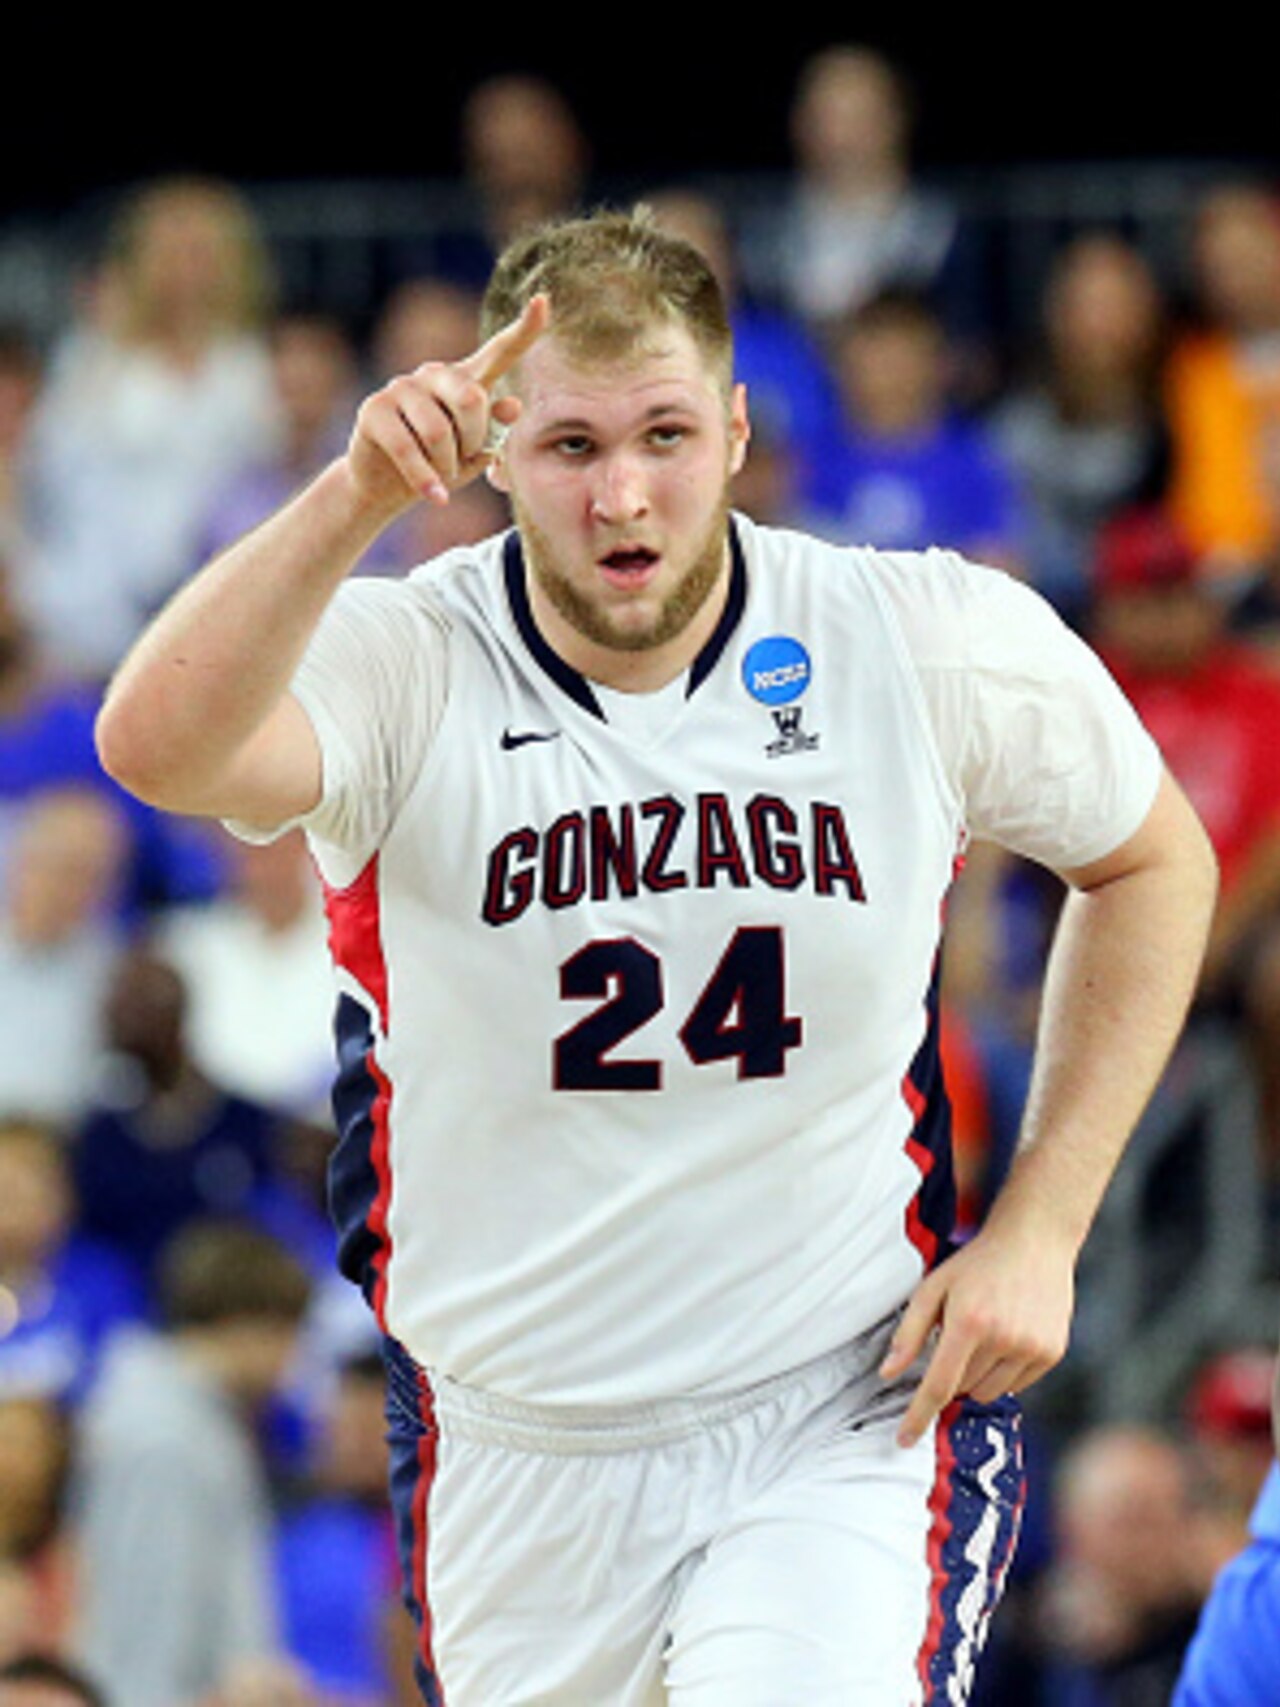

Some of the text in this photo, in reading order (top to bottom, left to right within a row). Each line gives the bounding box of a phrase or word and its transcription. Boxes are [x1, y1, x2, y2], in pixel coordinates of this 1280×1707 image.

[753, 662, 807, 691] NCAA
[481, 792, 868, 928] GONZAGA
[551, 925, 803, 1091] 24
